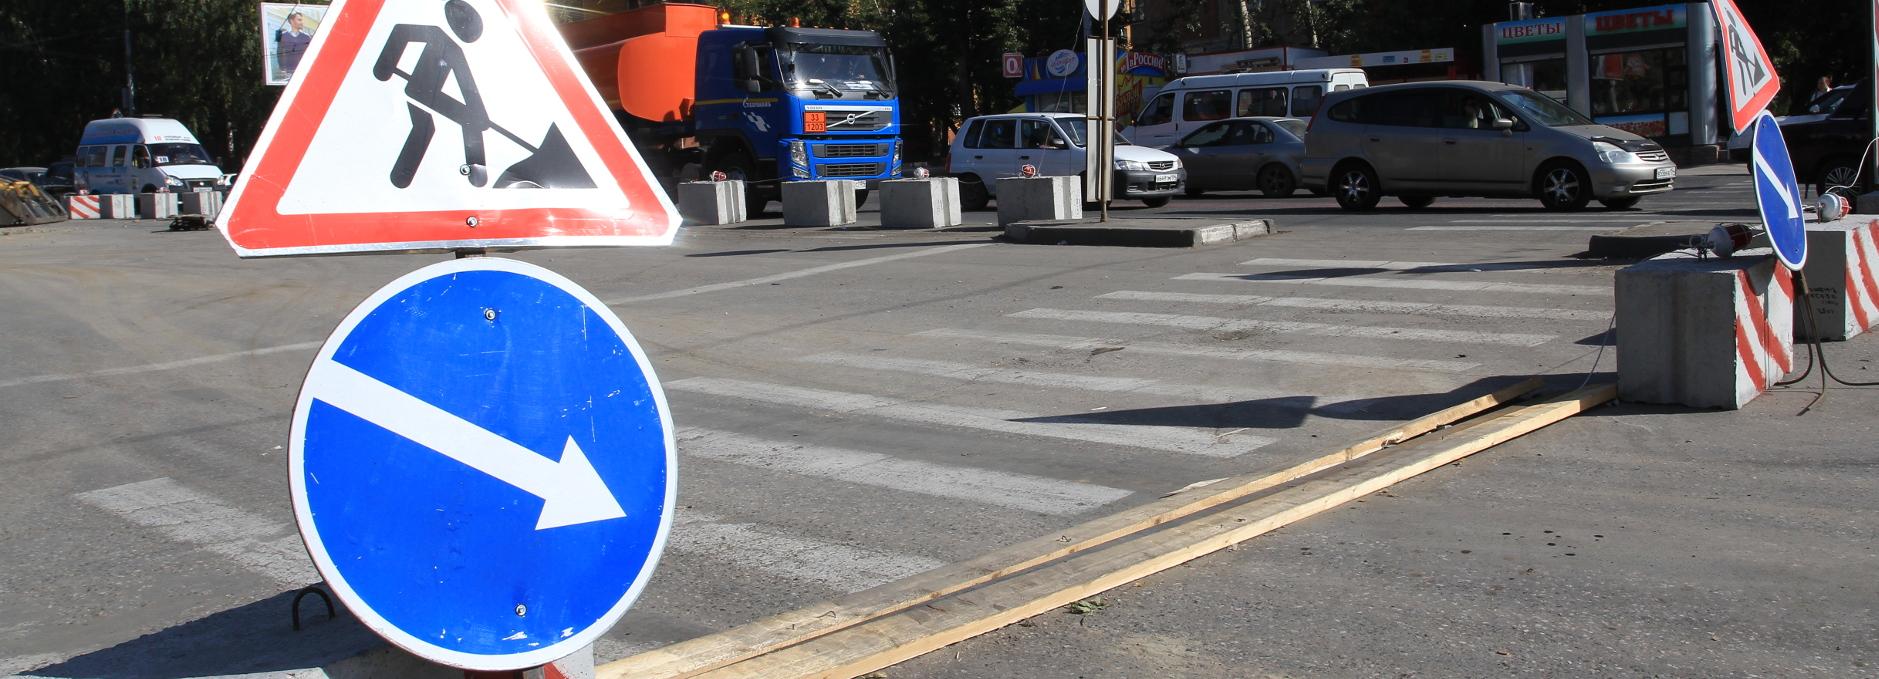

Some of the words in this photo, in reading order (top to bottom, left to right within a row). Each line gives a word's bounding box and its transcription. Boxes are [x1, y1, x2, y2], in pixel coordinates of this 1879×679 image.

[1596, 10, 1674, 32] ЦВЕТЫ
[1503, 23, 1561, 39] ЦВЕТЫ
[810, 113, 819, 122] 33
[807, 123, 824, 131] 1203
